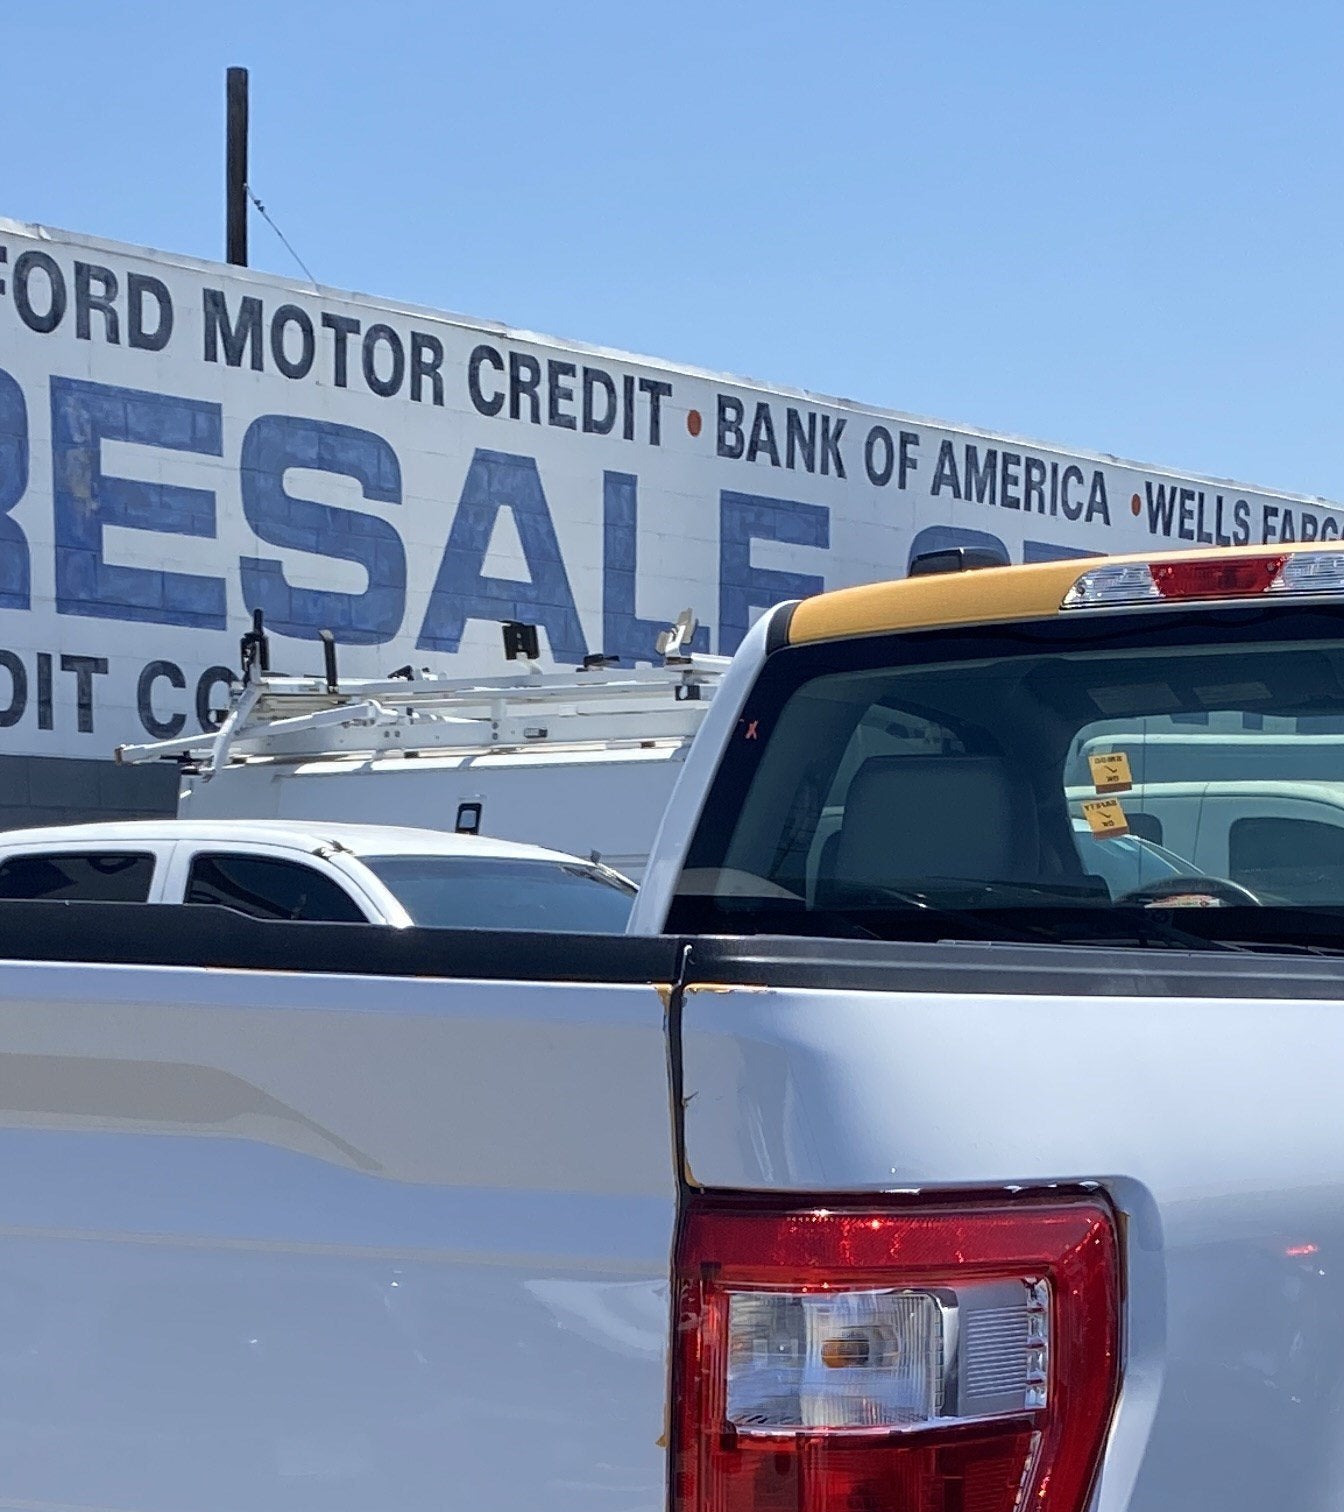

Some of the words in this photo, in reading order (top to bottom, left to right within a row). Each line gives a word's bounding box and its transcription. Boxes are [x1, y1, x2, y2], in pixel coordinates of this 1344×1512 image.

[203, 288, 445, 406] MOTOR
[468, 343, 673, 447] CREDIT
[716, 393, 847, 479] BANK
[864, 424, 921, 490] OF
[930, 440, 1111, 526] AMERICA
[1145, 481, 1250, 546] WELLS
